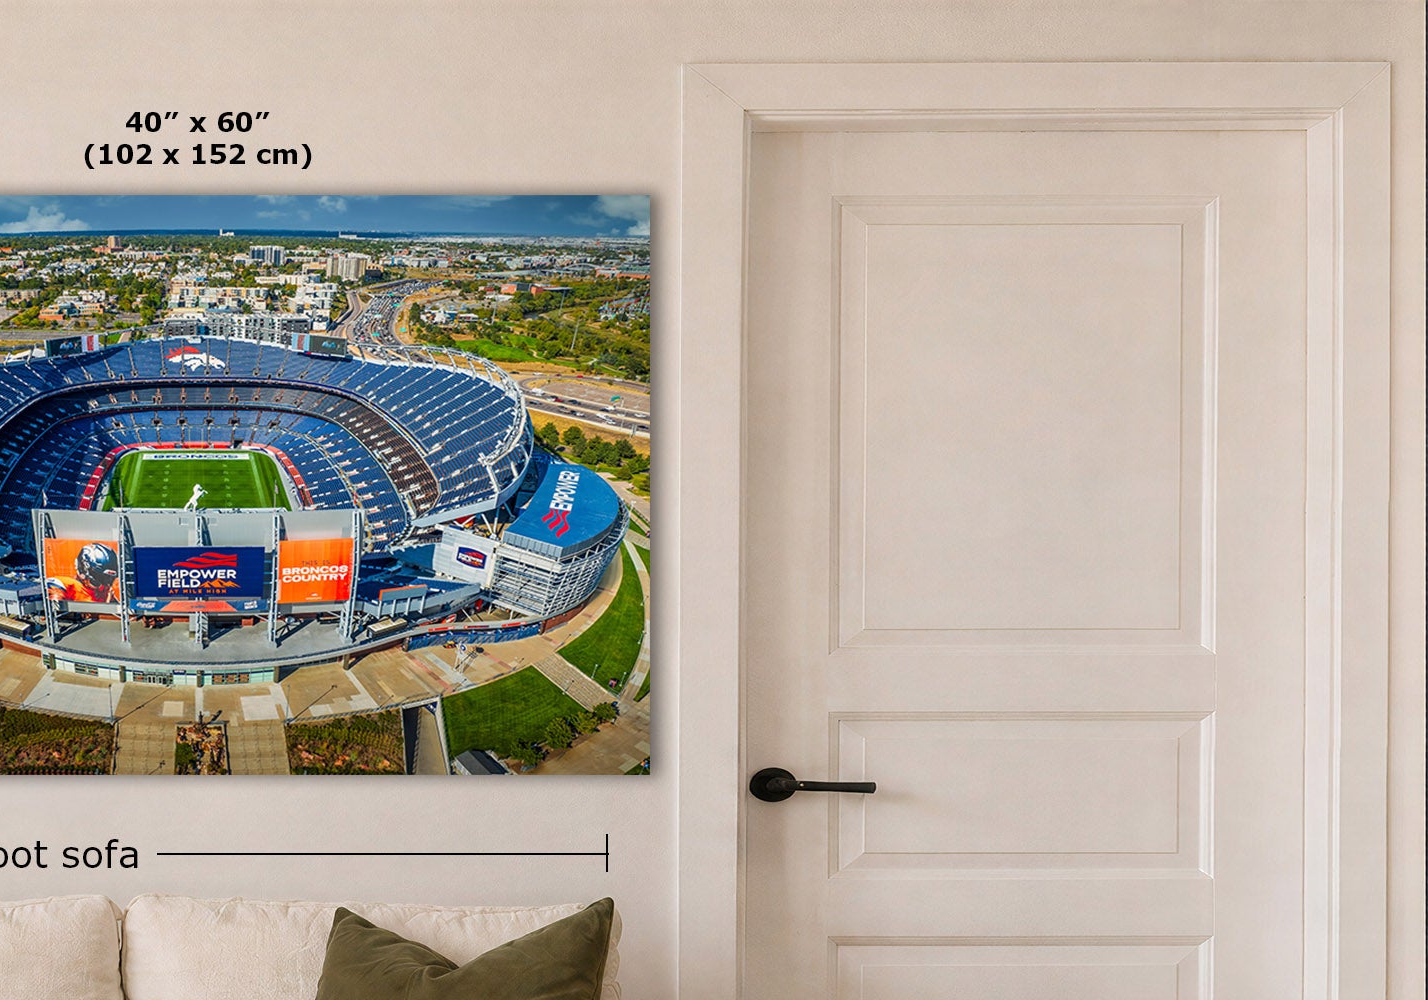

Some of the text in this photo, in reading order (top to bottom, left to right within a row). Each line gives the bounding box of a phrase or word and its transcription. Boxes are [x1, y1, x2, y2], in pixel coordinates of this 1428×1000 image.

[549, 470, 580, 512] EMPOWER
[157, 569, 237, 579] EMPOWER
[282, 565, 349, 575] BRONCOS
[282, 573, 348, 583] COUNTRY
[157, 579, 201, 588] FIELD
